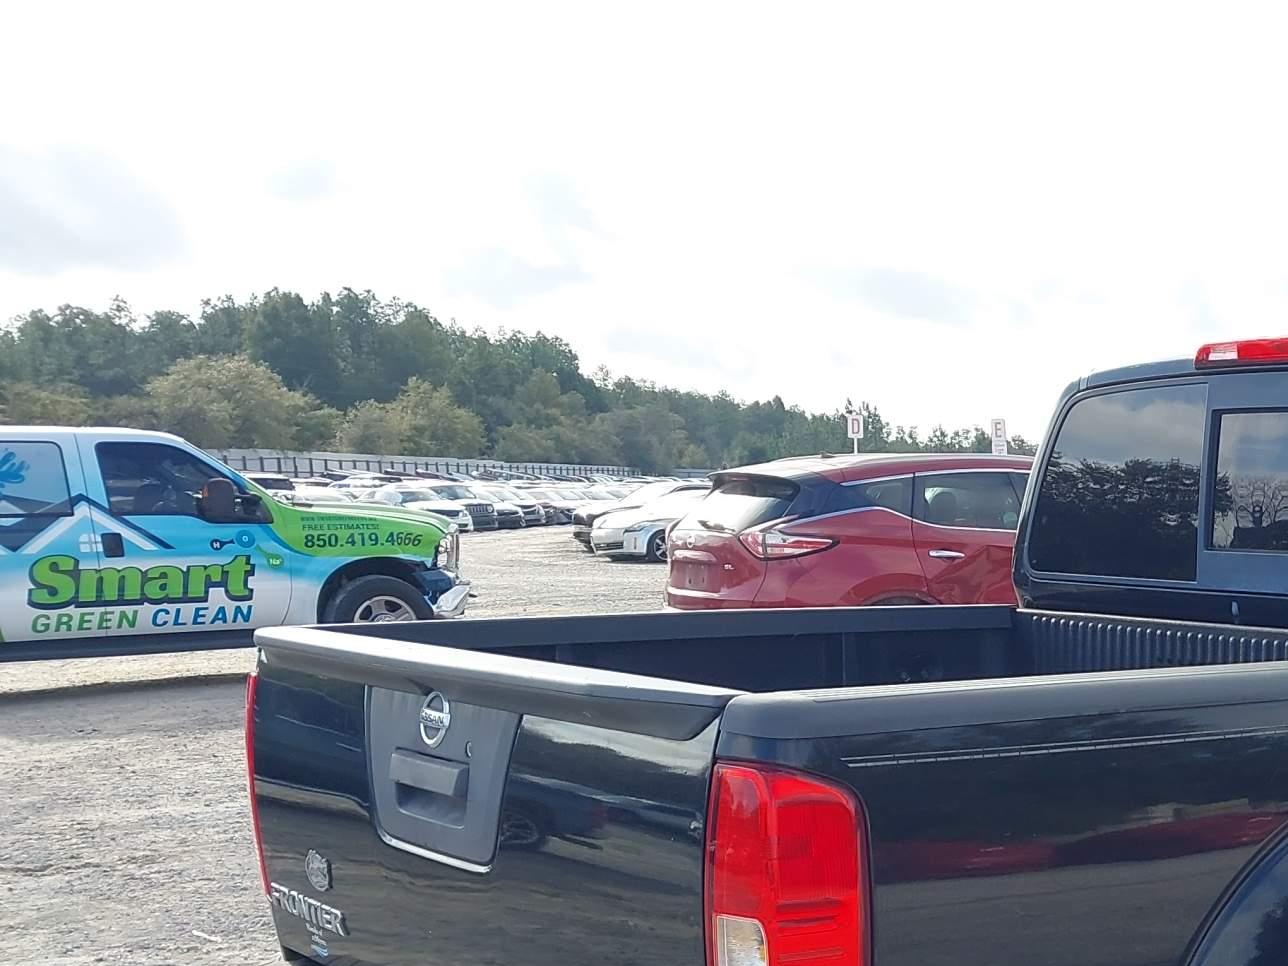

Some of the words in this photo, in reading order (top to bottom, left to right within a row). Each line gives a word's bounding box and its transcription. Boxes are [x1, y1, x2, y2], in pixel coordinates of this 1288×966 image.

[304, 531, 423, 548] 850.419.4666
[28, 555, 255, 610] Smart
[31, 609, 139, 633] GREEN
[151, 605, 253, 627] CLEAN
[270, 882, 345, 936] FRONTIER
